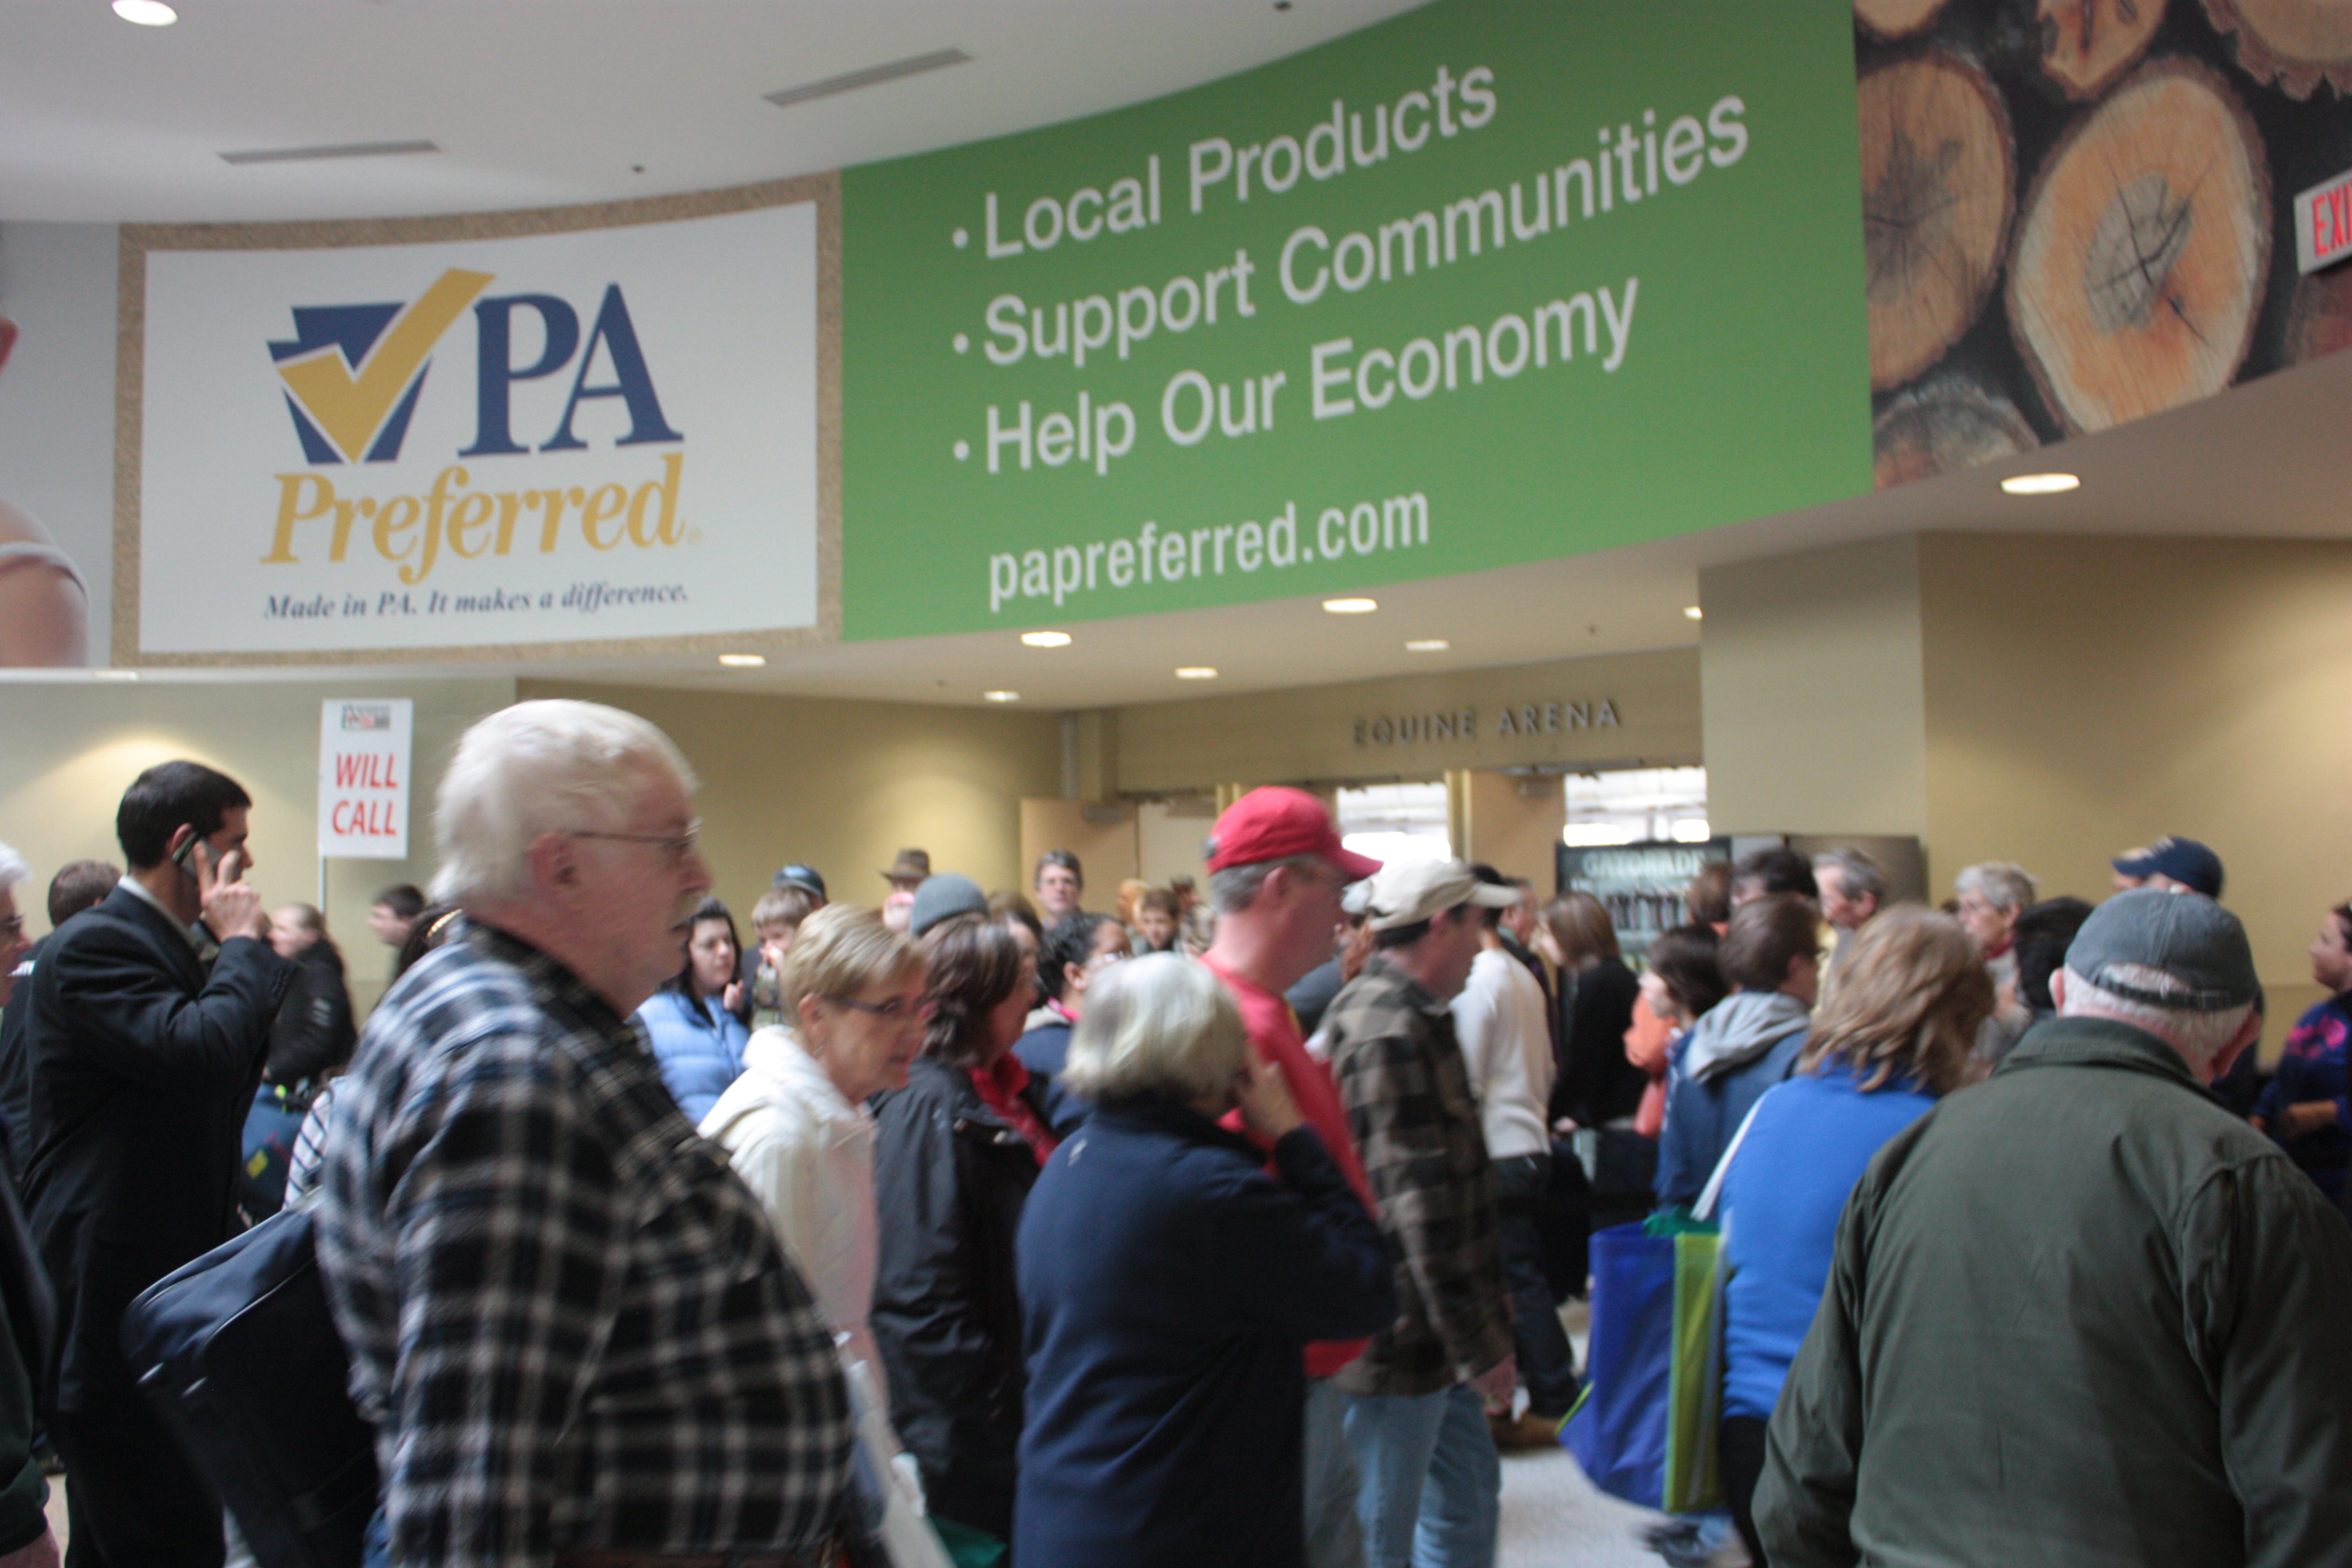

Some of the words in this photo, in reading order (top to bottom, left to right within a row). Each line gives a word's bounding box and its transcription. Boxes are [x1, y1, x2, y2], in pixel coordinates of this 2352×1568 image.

[986, 154, 1162, 259] Local
[1189, 64, 1498, 215] Products
[2312, 183, 2352, 256] EXI
[984, 248, 1256, 369] Support
[1278, 95, 1749, 306] Communities
[458, 282, 685, 457] PA
[987, 390, 1137, 476] Help
[1161, 369, 1287, 447] Our
[1310, 277, 1639, 421] Economy
[259, 452, 686, 586] Preferred
[989, 492, 1430, 615] papreferred.com
[263, 594, 335, 619] Made
[342, 592, 368, 617] in
[377, 590, 418, 616] PA.
[427, 590, 448, 614] It
[455, 586, 532, 613] makes
[538, 591, 554, 609] a
[560, 581, 688, 614] difference.
[336, 753, 397, 788] WILL
[1353, 709, 1476, 748] EQUINE
[1499, 699, 1621, 737] ARENA
[332, 800, 396, 835] CALL
